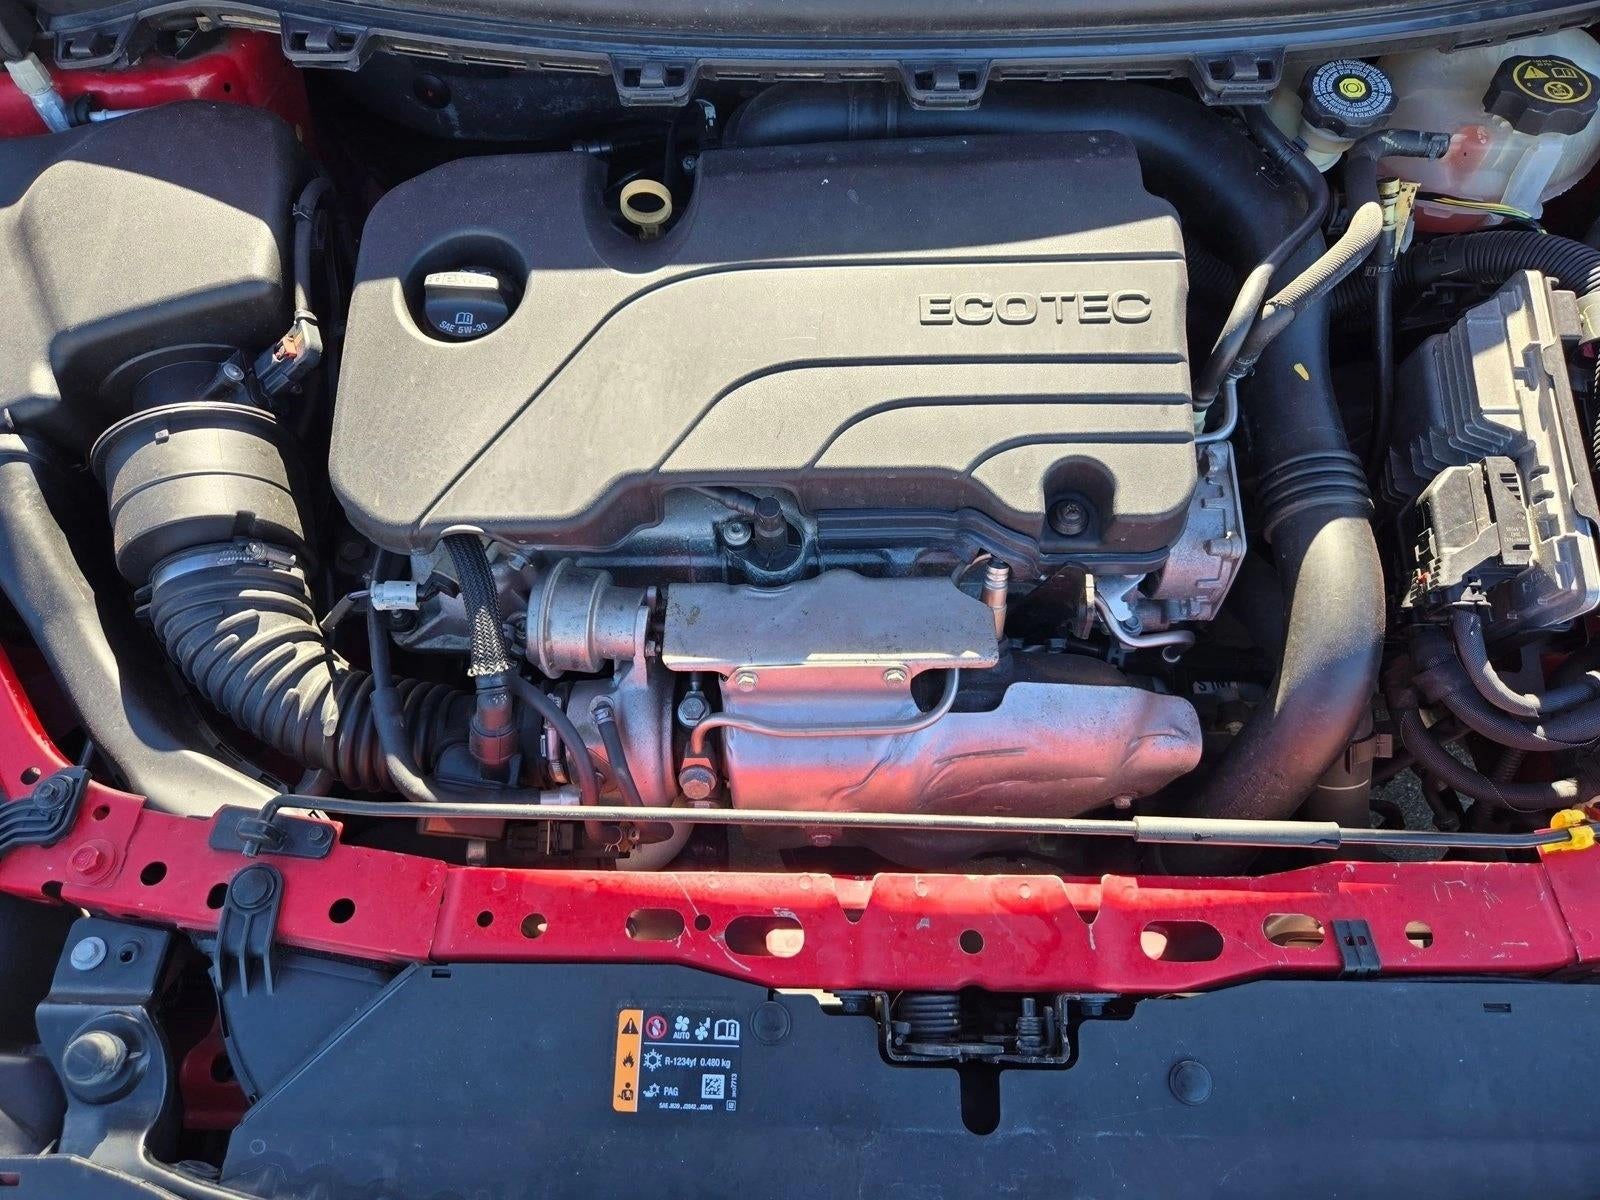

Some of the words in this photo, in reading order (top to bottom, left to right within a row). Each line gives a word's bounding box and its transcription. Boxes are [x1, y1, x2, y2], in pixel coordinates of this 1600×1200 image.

[919, 290, 1152, 325] ECOTEC
[439, 320, 455, 332] SAE
[457, 322, 488, 334] 5W-30
[673, 1031, 690, 1040] AUTO
[665, 1057, 697, 1067] R-1234yf
[700, 1058, 720, 1067] 0.480
[721, 1058, 731, 1069] kg
[663, 1086, 679, 1097] PAG
